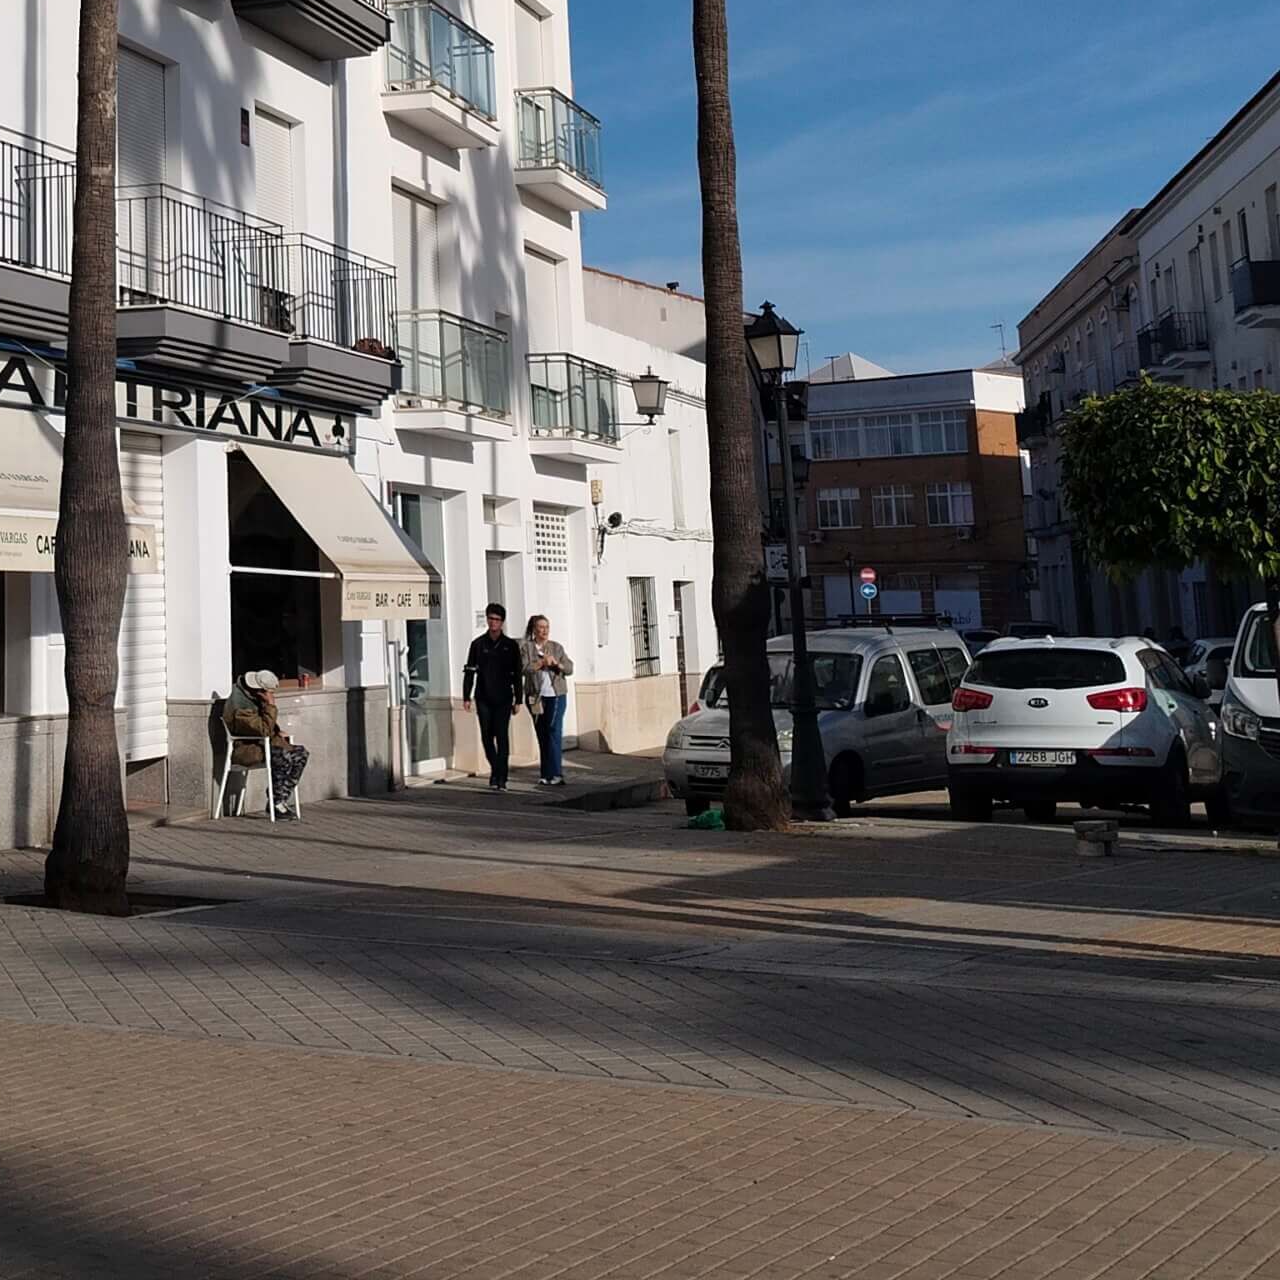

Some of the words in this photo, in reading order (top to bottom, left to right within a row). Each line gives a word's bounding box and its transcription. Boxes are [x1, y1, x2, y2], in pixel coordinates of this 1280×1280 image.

[116, 375, 322, 447] TRIANA
[0, 531, 29, 544] VARGAS
[36, 534, 56, 554] CAF
[375, 593, 389, 608] BAR
[397, 588, 412, 608] CAFÉ
[1017, 751, 1047, 763] 2268
[1050, 751, 1074, 763] JGH
